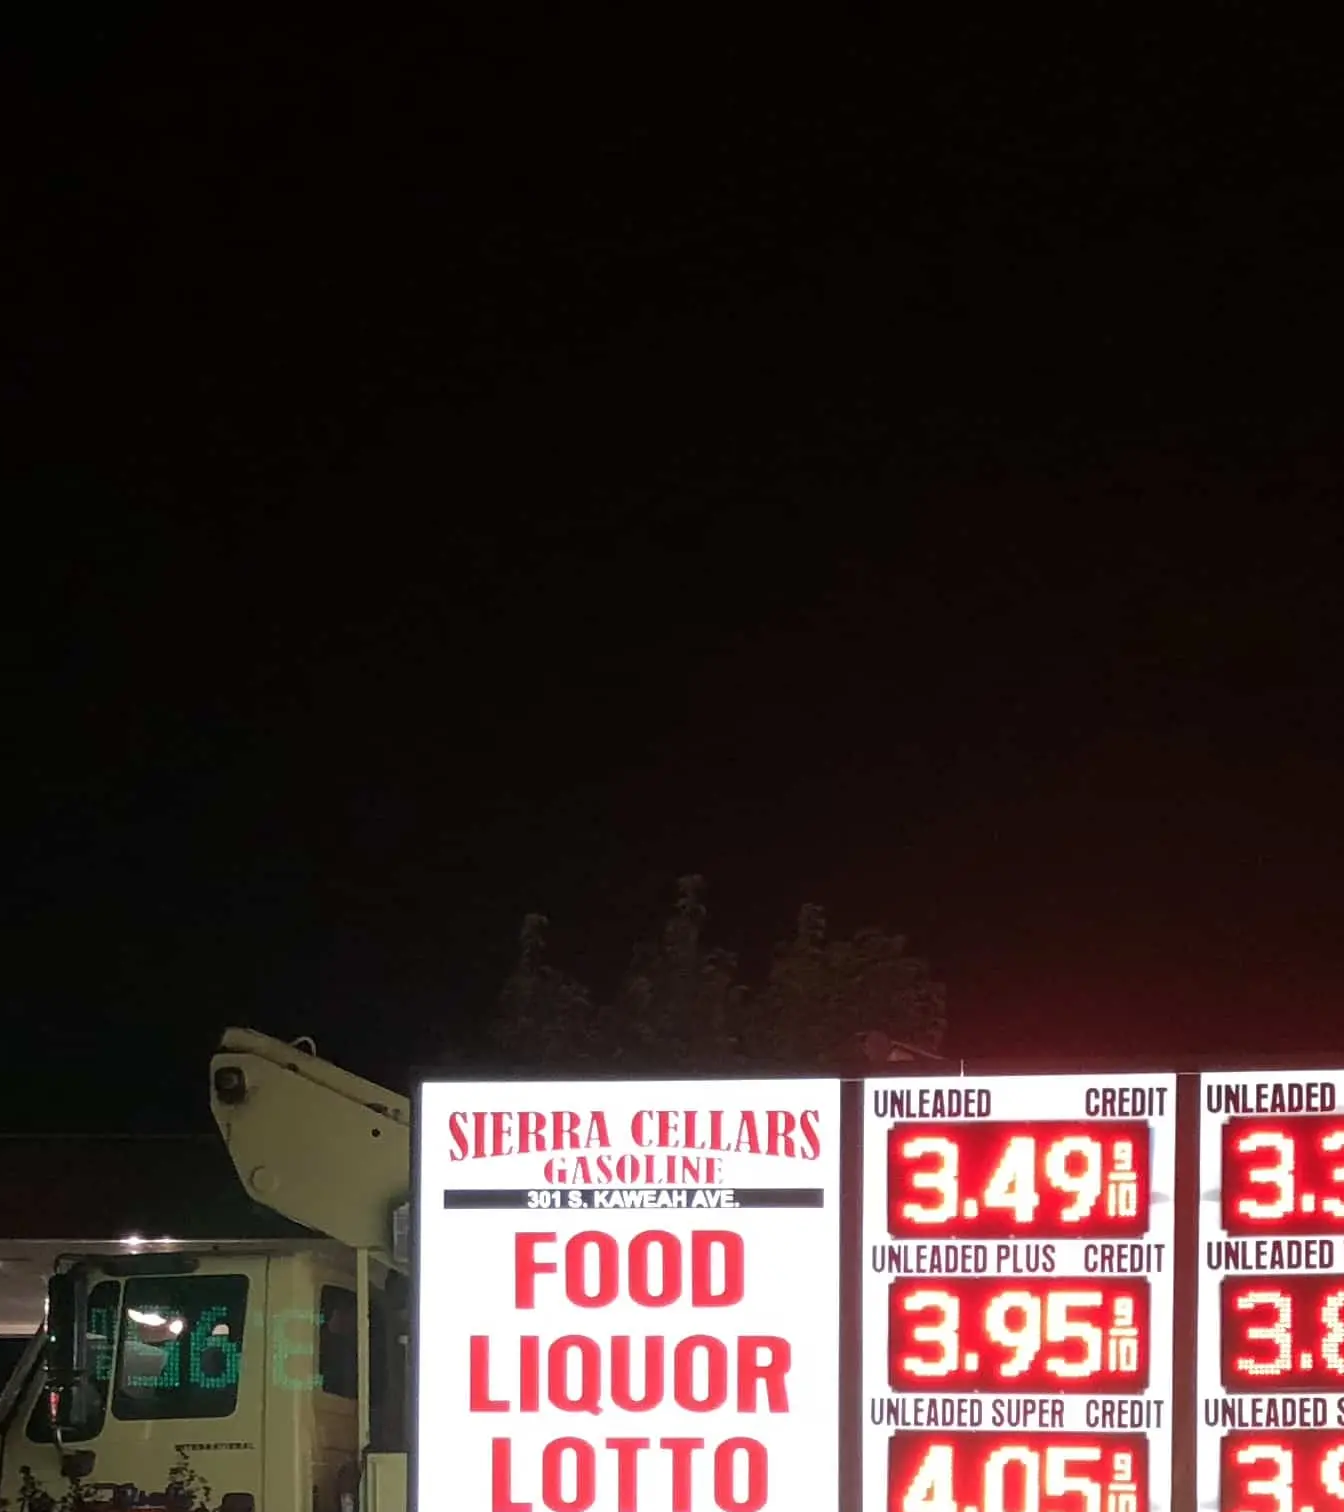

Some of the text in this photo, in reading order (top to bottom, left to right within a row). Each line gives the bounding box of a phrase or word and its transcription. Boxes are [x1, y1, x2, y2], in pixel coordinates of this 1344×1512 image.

[874, 1087, 1168, 1118] UNLEADED CREDIT
[1207, 1082, 1336, 1113] UNLEADED
[448, 1109, 821, 1162] SIERRA CELLARS
[543, 1153, 724, 1185] GASOLINE
[903, 1136, 1102, 1224] 3.49
[527, 1189, 741, 1209] 301 S. KAWEAH AVE.
[514, 1229, 745, 1309] FOOD
[871, 1244, 1166, 1274] UNLEADED PLUS CREDIT
[1207, 1240, 1334, 1270] UNLEADED
[903, 1290, 1103, 1378] 3.95
[470, 1334, 792, 1416] LIQUOR
[870, 1398, 1164, 1429] UNLEADED SUPER CREDIT
[1204, 1397, 1327, 1428] UNLEADED
